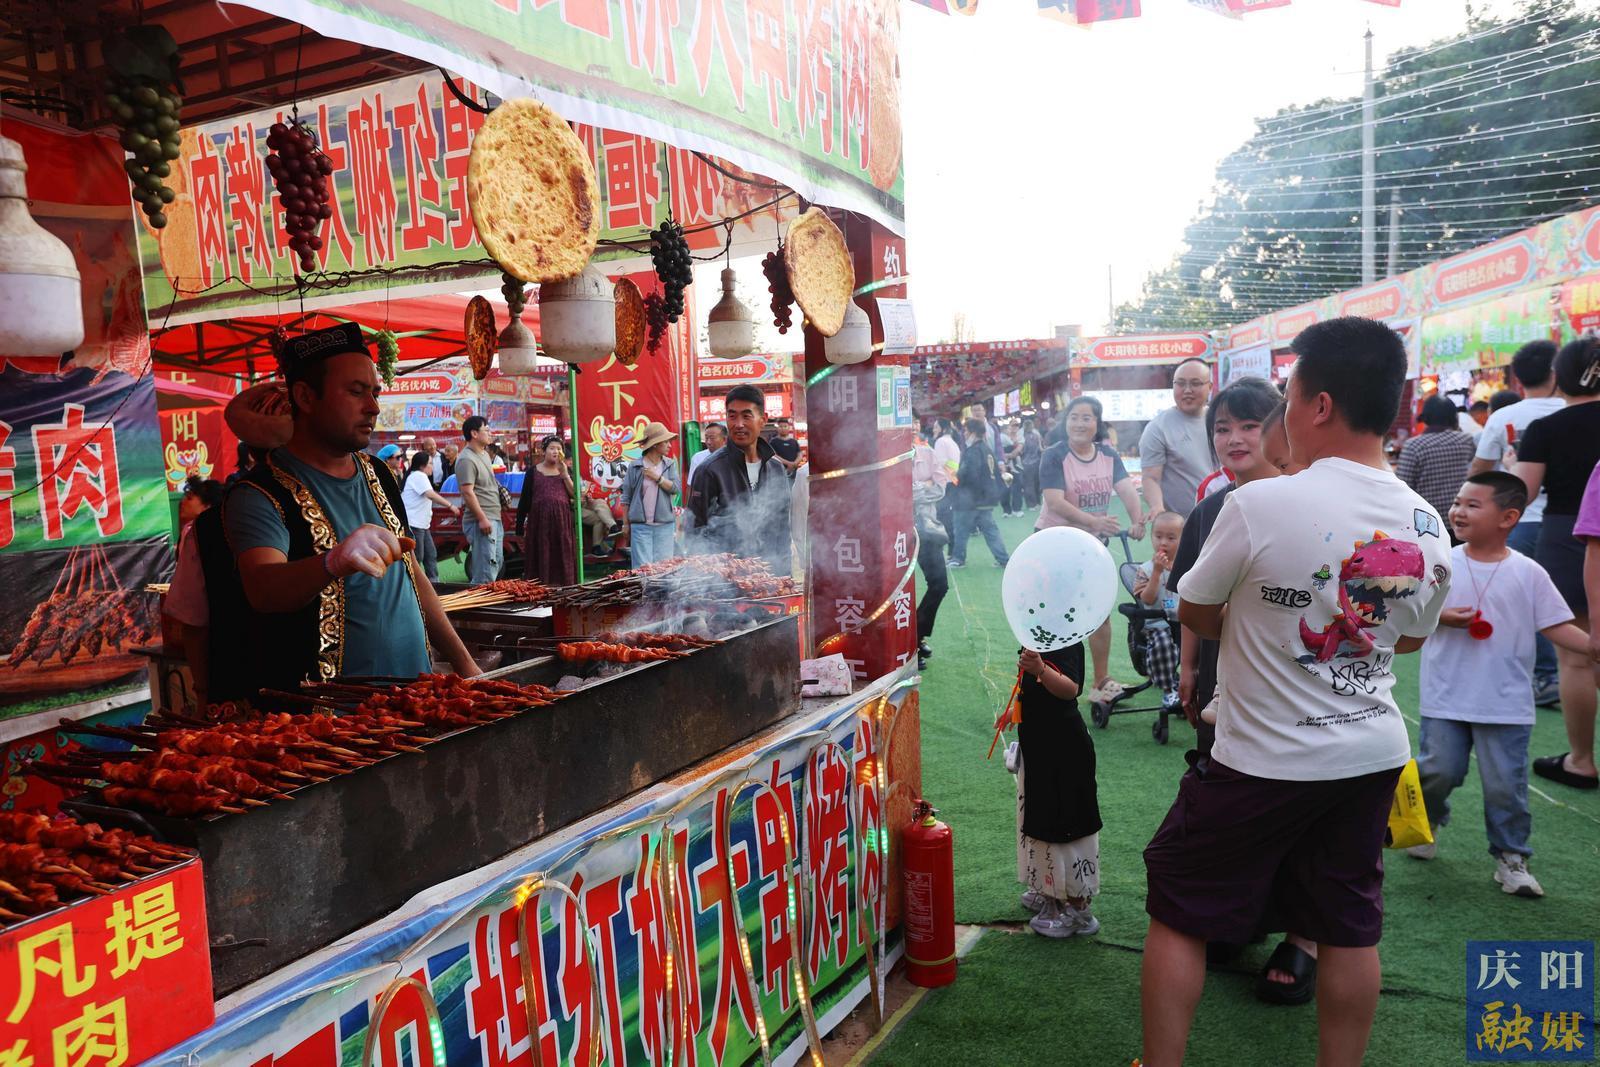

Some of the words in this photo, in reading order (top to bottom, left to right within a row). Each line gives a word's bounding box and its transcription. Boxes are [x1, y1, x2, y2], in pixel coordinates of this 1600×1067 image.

[1104, 342, 1193, 357] 庆阳特色名优小吃
[1261, 585, 1312, 608] THE
[0, 997, 130, 1067] 肉
